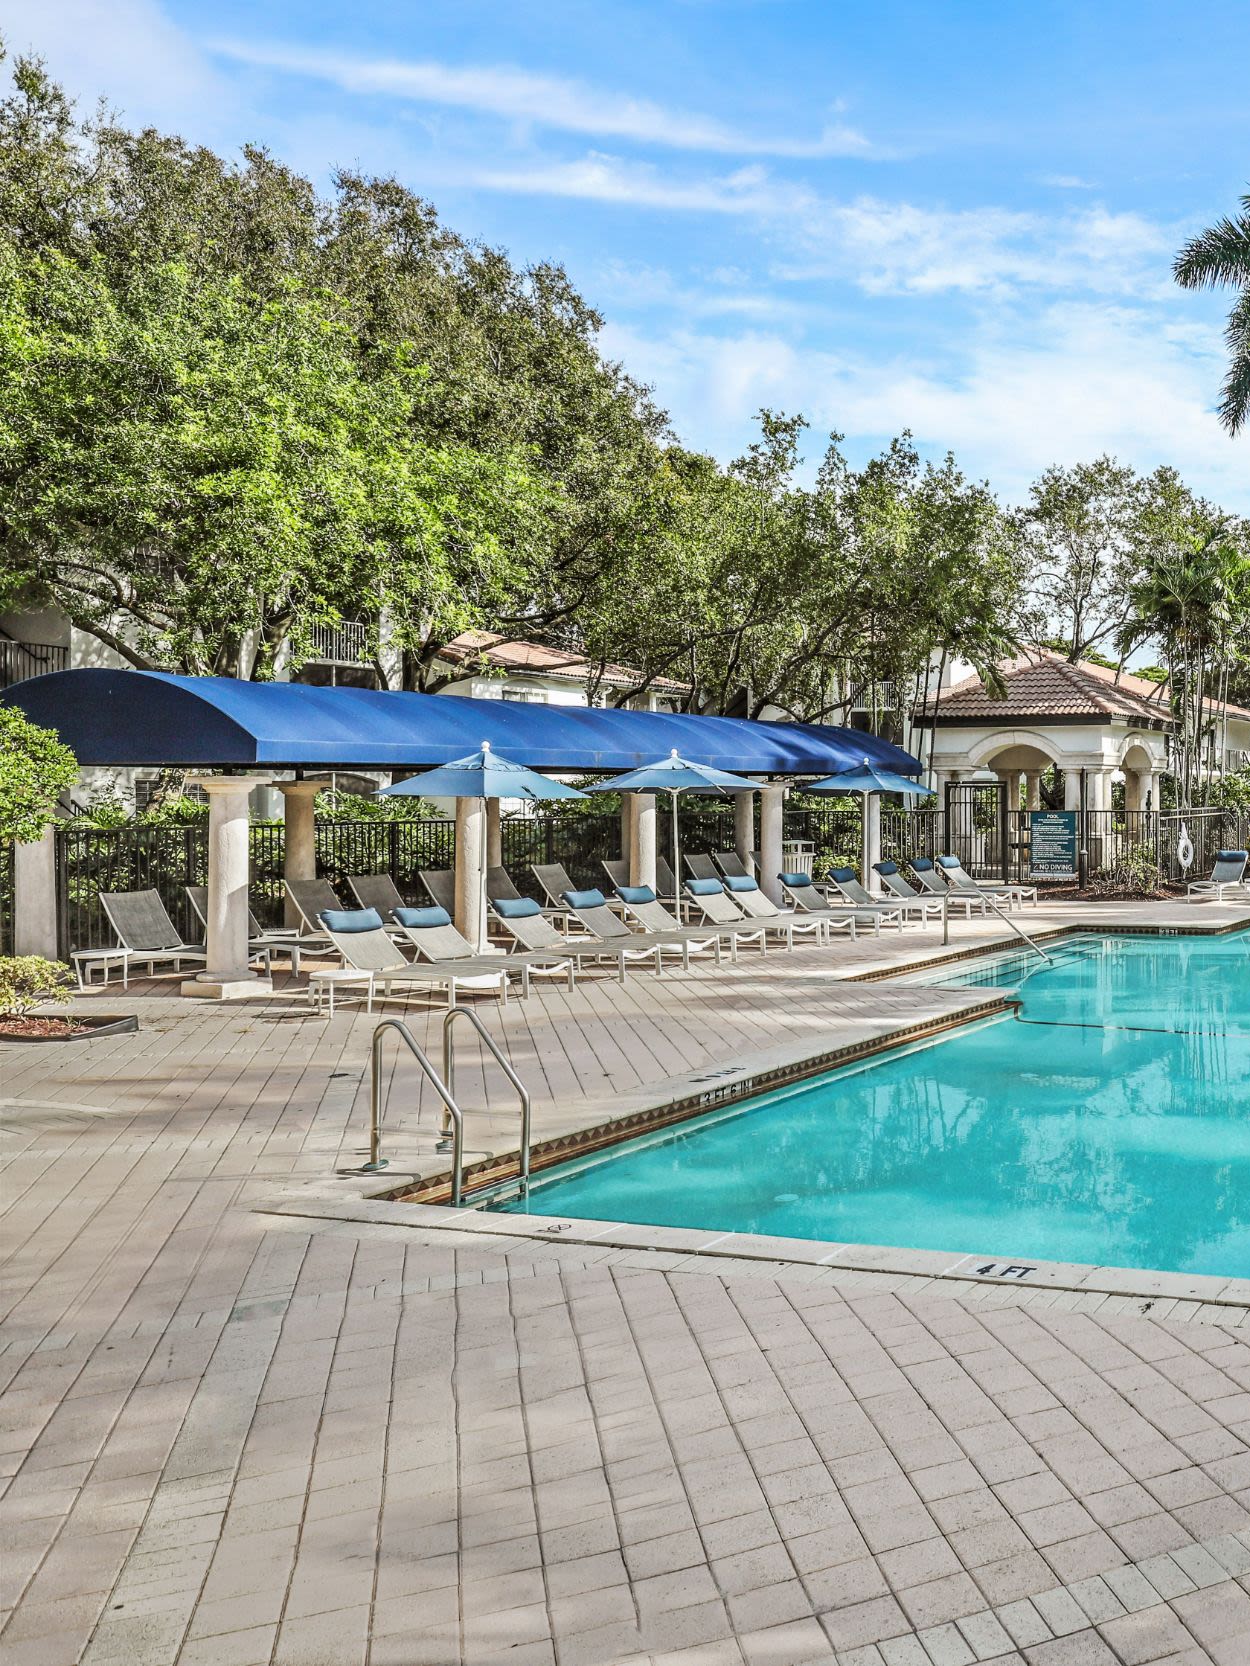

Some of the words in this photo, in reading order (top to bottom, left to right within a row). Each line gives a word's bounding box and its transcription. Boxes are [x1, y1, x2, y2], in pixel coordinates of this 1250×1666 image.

[715, 1087, 726, 1102] FT
[976, 1264, 997, 1275] 4
[999, 1266, 1037, 1278] FT
